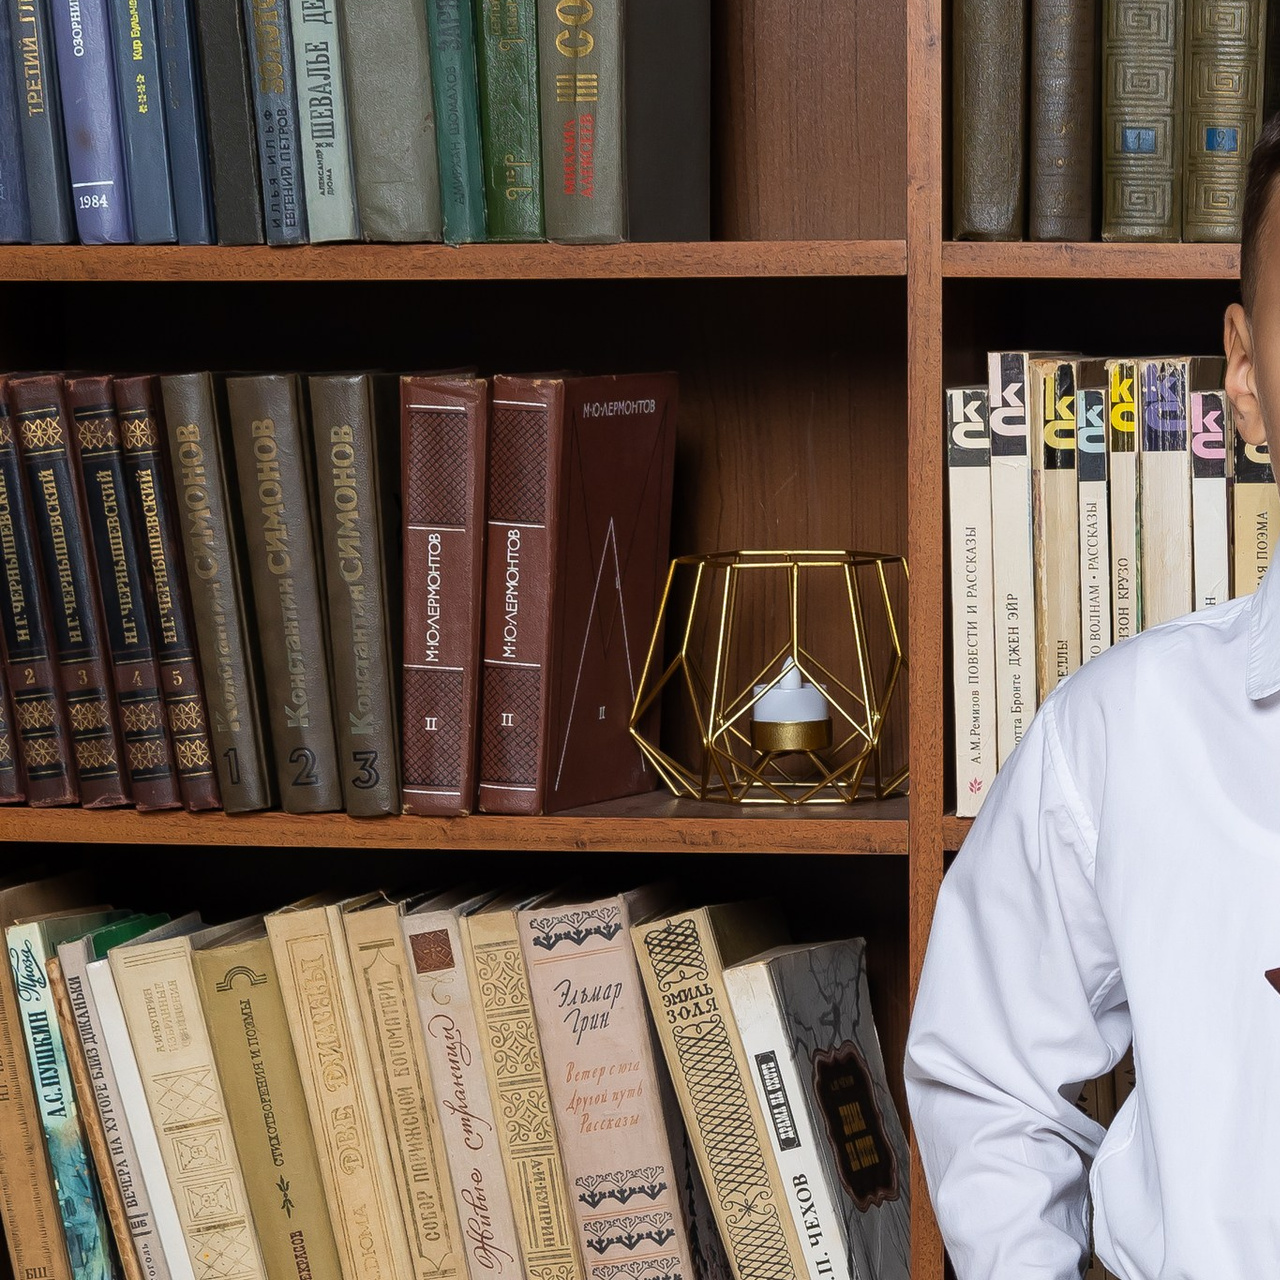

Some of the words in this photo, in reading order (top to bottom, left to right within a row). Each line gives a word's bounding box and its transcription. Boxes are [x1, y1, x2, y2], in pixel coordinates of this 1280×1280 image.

[131, 40, 143, 60] Кир
[18, 36, 43, 116] ТРЕТИЙ
[305, 41, 334, 139] ШЕВАЛЬЕ
[262, 109, 277, 165] ИЛЬФ
[277, 109, 291, 162] ПЕТРОВ
[79, 195, 108, 208] 1984
[267, 177, 281, 228] ИЛЬЯ
[280, 166, 296, 226] ЕВГЕНИЙ
[176, 423, 218, 579] СИМОНОВ
[251, 418, 291, 575] СИМОНОВ
[331, 423, 364, 582] СИМОНОВ
[39, 468, 79, 613] ЧЕРНЫШЕВСКИЙ
[96, 469, 133, 611] ЧЕРНЫШЕВСКИЙ
[136, 468, 172, 611] ЧЕРНЫШЕВСКИЙ
[1085, 502, 1099, 572] РАССКАЗЫ
[1254, 512, 1269, 561] ПОЭМА
[963, 526, 978, 600] РАССКАЗЫ
[1116, 557, 1131, 600] КРУЗО
[1006, 593, 1020, 621] ЭЙР
[1088, 585, 1101, 641] ВОЛНАМ
[966, 620, 980, 686] ПОВЕСТИ
[1008, 627, 1022, 667] ДЖЕН
[173, 670, 184, 686] 5
[1010, 674, 1024, 714] Бронте
[289, 747, 320, 787] 2
[353, 751, 380, 790] 3
[9, 939, 47, 1003] Проза
[553, 979, 623, 1009] Эльмар
[662, 983, 714, 1008] ЭМИЛЬ
[69, 975, 98, 1045] ДИКАНЬКИ
[240, 997, 260, 1047] ПОЭМЫ
[300, 952, 349, 1093] ДИАНЫ
[378, 980, 411, 1077] БОГОМАТЕРИ
[563, 1008, 610, 1045] Грин
[86, 1047, 108, 1081] БЛИЗ
[566, 1062, 606, 1085] Ветер
[758, 1061, 779, 1091] ОХОТЕ
[97, 1083, 121, 1132] ХУТОРЕ
[253, 1061, 285, 1167] СТИХОТВОРЕНИЯ
[566, 1090, 607, 1114] Другой
[612, 1082, 643, 1109] путь
[580, 1113, 640, 1134] Рассказы
[773, 1106, 795, 1139] ДРАМА
[109, 1136, 124, 1155] НА
[331, 1104, 365, 1176] ДВЕ
[396, 1086, 432, 1184] ПАРИЖСКОЙ
[117, 1158, 139, 1209] ВЕЧЕРА
[417, 1192, 442, 1242] СОБОР
[461, 1168, 513, 1274] Живые
[791, 1174, 826, 1249] ЧЕХОВ
